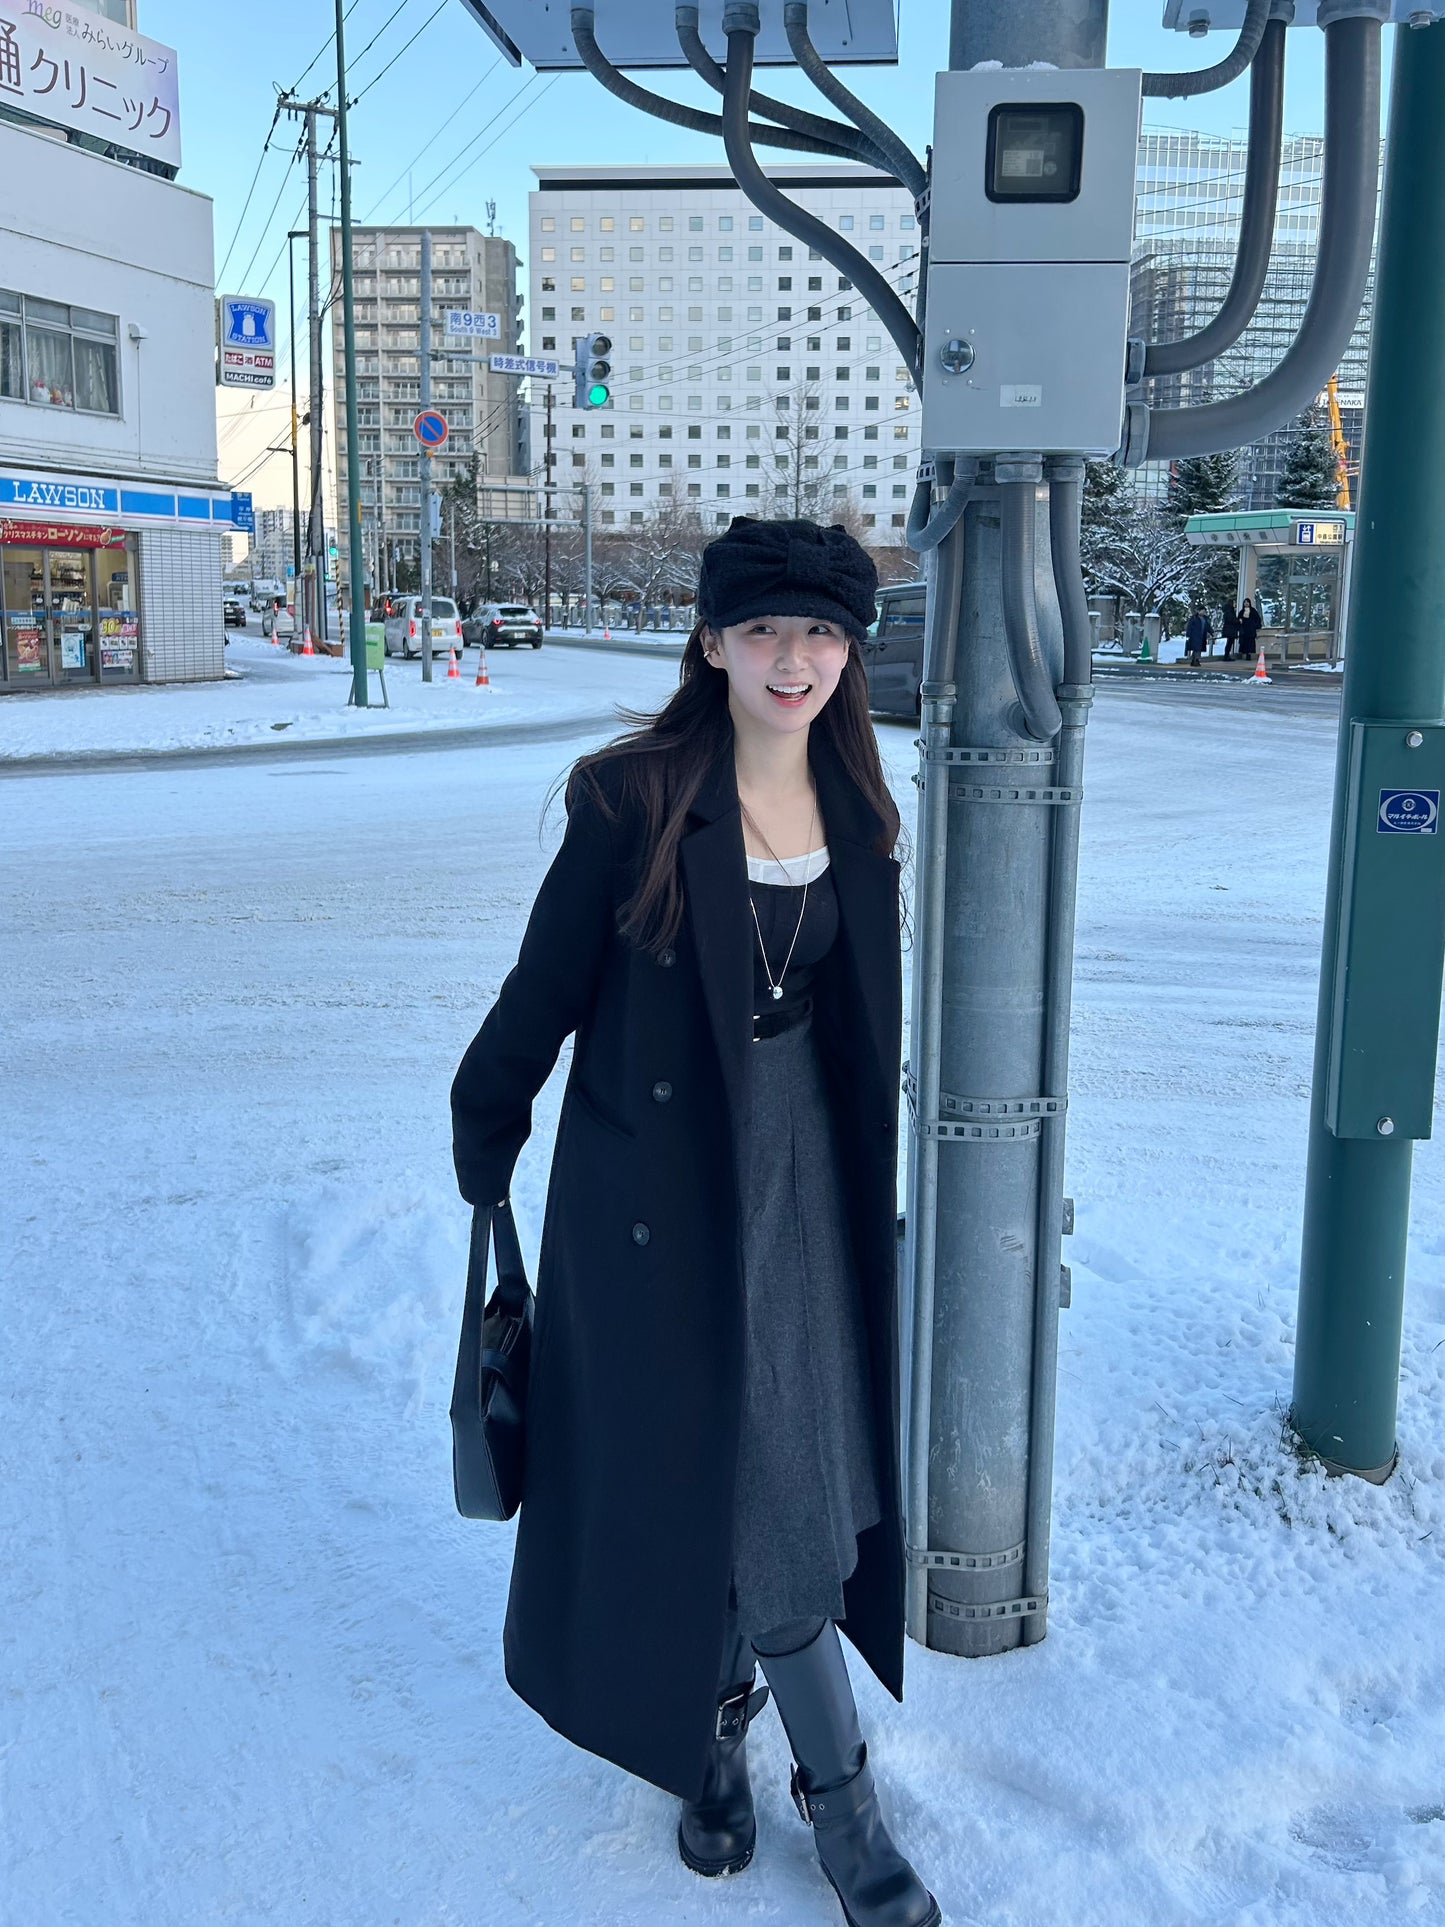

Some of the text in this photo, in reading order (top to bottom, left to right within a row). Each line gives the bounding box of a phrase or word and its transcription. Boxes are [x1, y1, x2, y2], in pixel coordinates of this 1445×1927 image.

[82, 23, 169, 74] みらいグループ
[231, 304, 267, 316] LAWSON
[450, 312, 497, 328] 南9西3
[231, 332, 266, 344] STATION
[255, 356, 273, 367] ATM
[493, 356, 557, 374] 時差式信号機
[226, 372, 254, 383] MACHI
[12, 481, 105, 508] LAWSON
